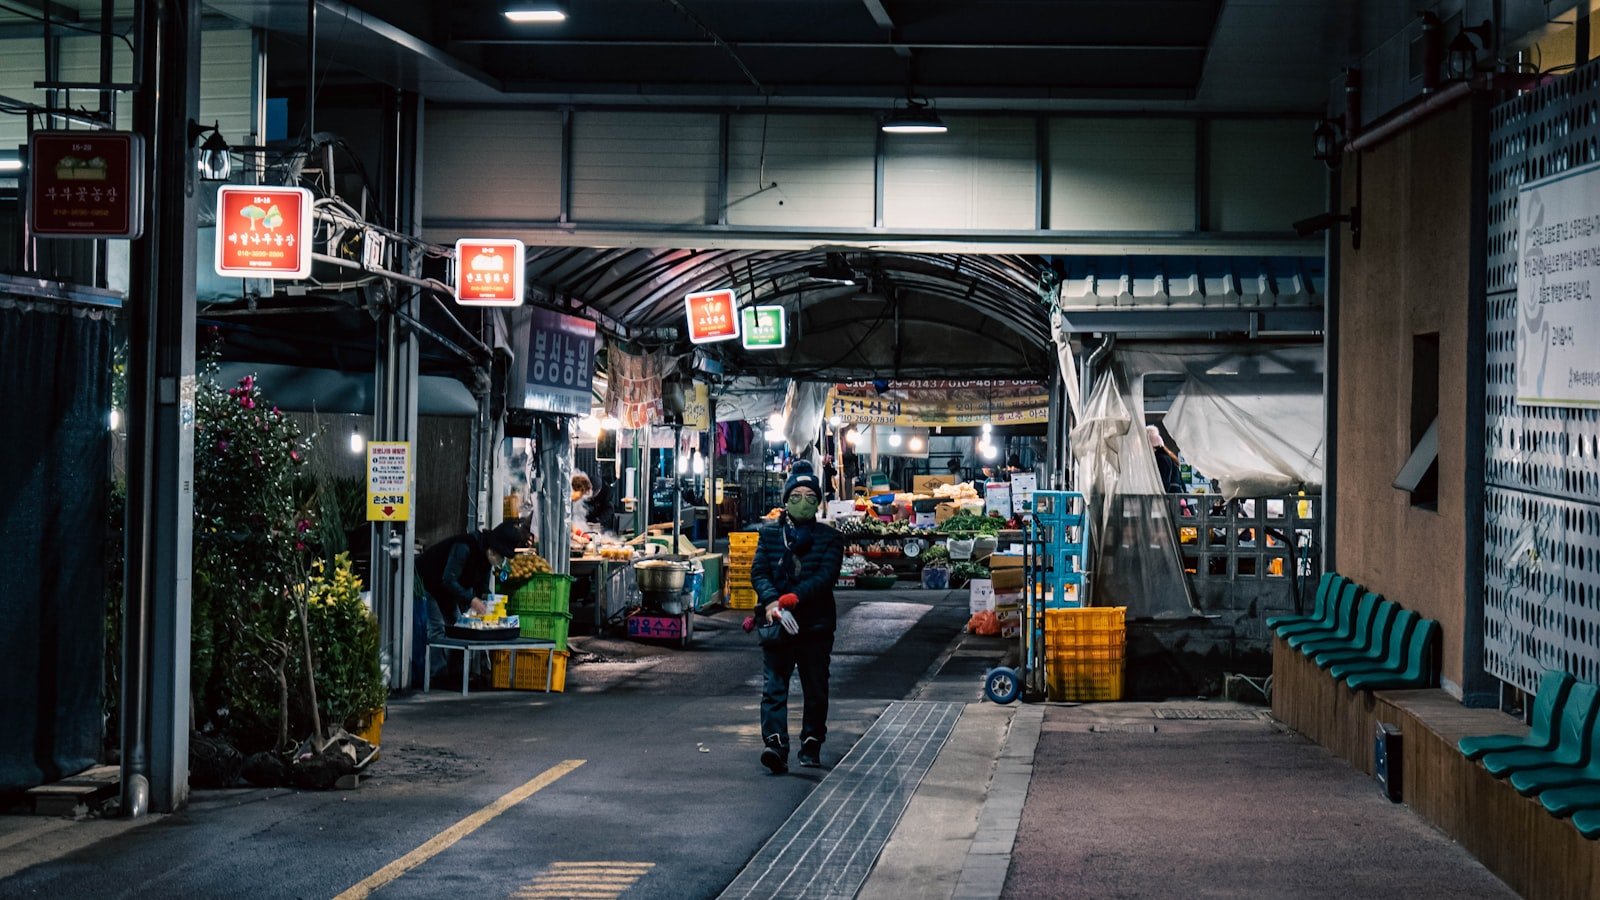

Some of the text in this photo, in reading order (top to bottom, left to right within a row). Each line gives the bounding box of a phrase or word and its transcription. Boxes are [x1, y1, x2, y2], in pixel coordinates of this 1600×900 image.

[43, 185, 119, 203] 부부꽃농장
[373, 495, 404, 505] 손소독제
[629, 618, 680, 636] 찰옥수수
